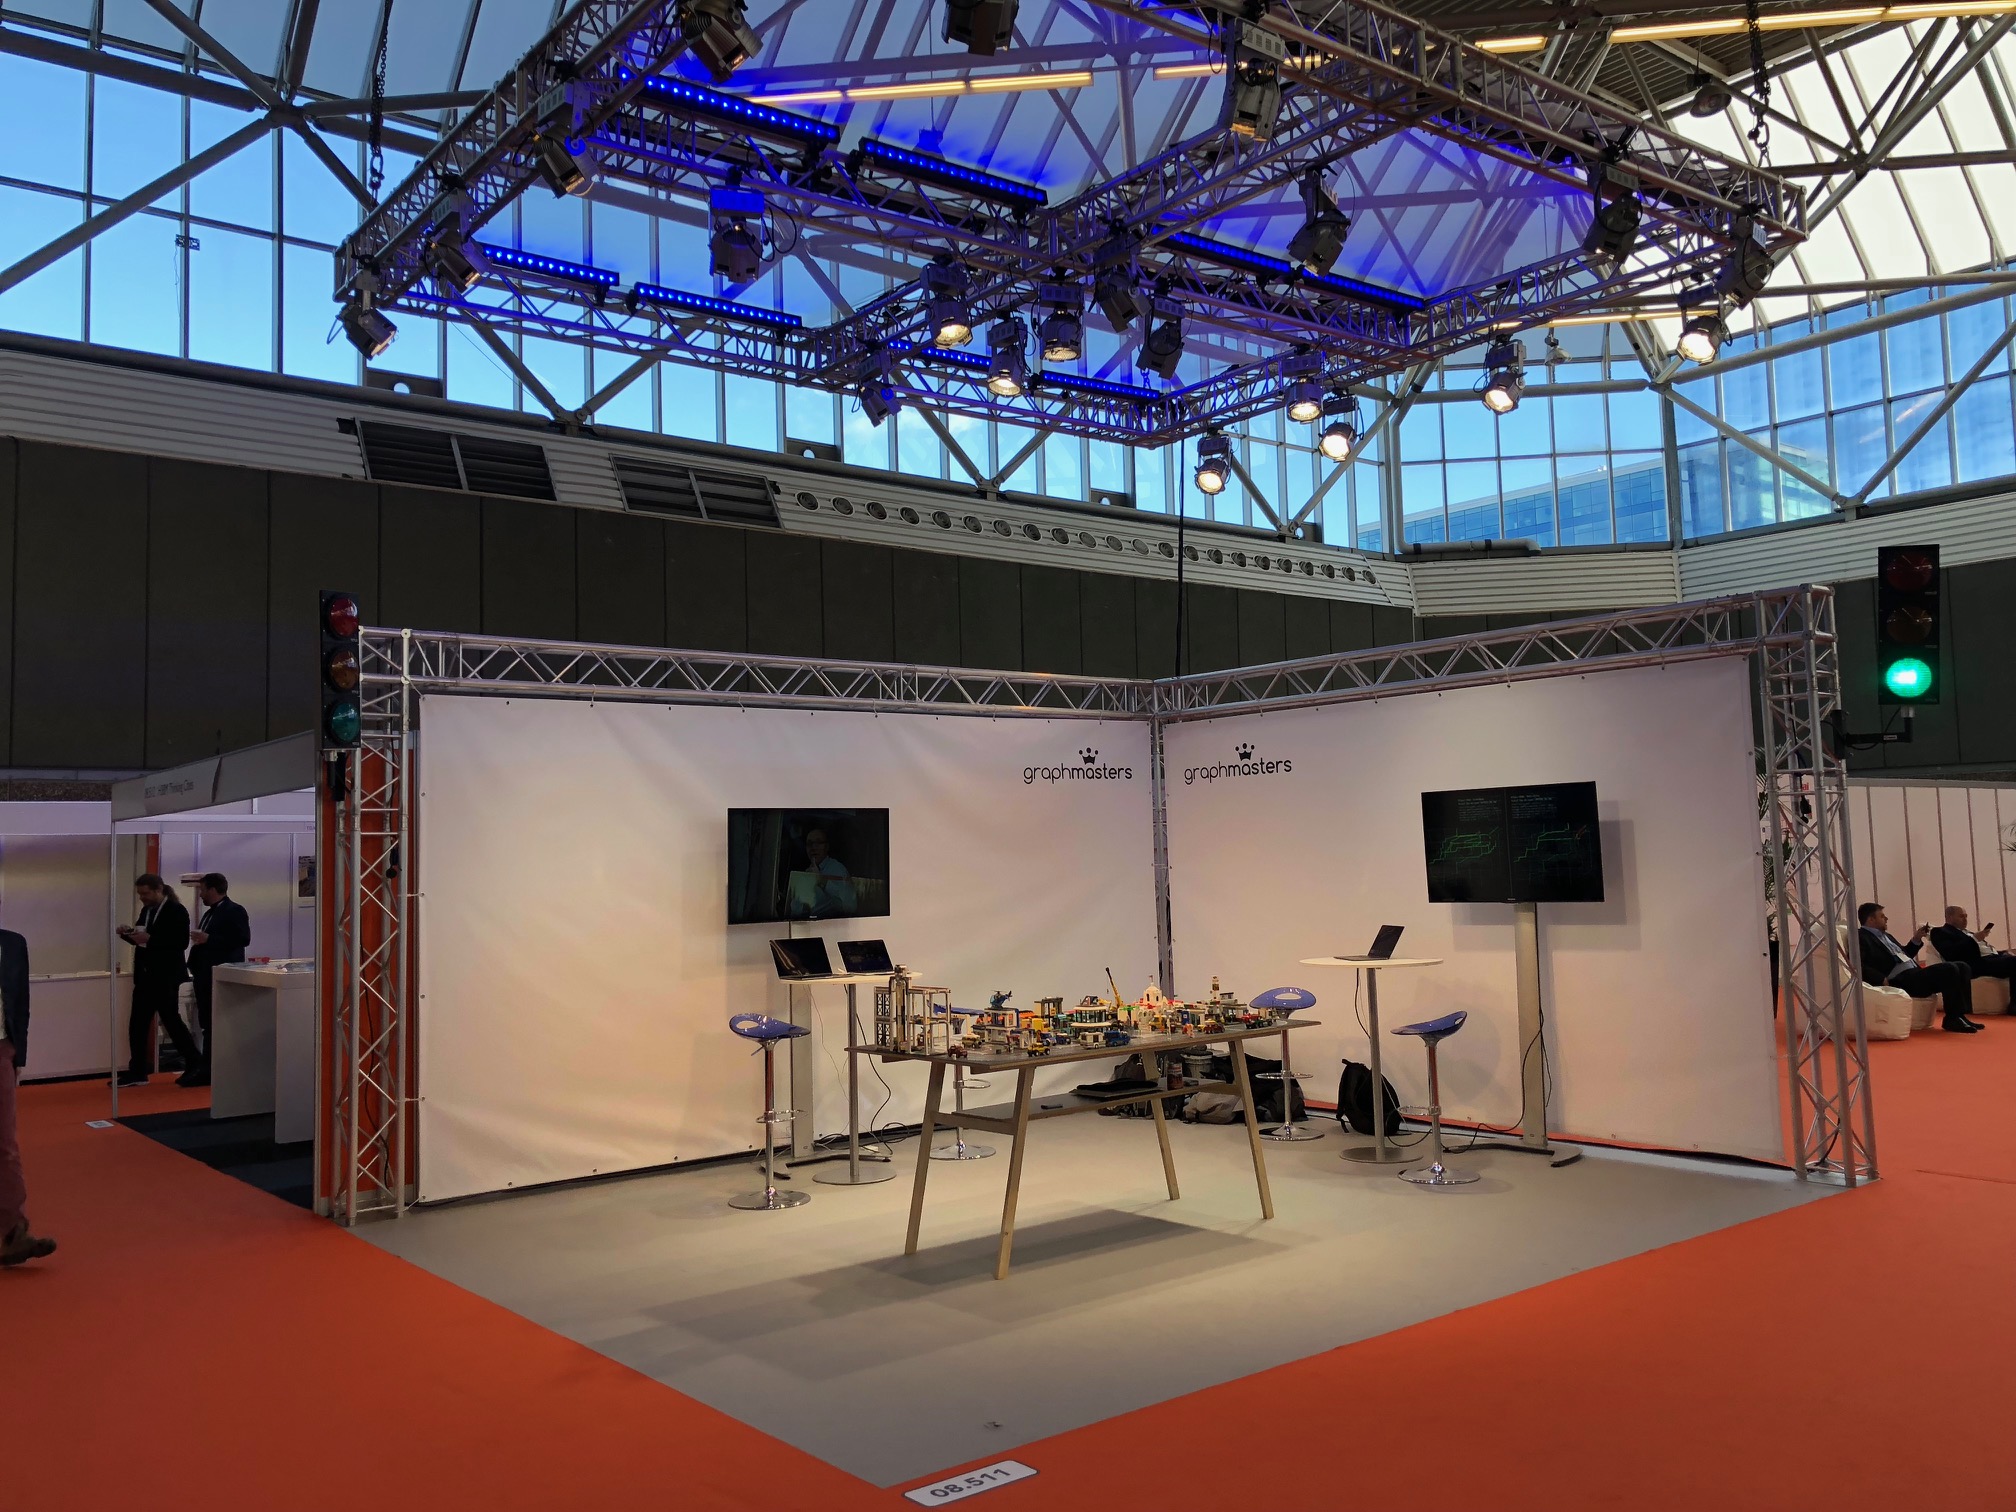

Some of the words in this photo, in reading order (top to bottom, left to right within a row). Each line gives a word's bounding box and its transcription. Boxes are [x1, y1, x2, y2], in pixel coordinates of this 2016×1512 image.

[1023, 763, 1133, 785] graphmasters
[1184, 757, 1292, 785] graphmasters
[930, 1468, 1011, 1498] 08.511
